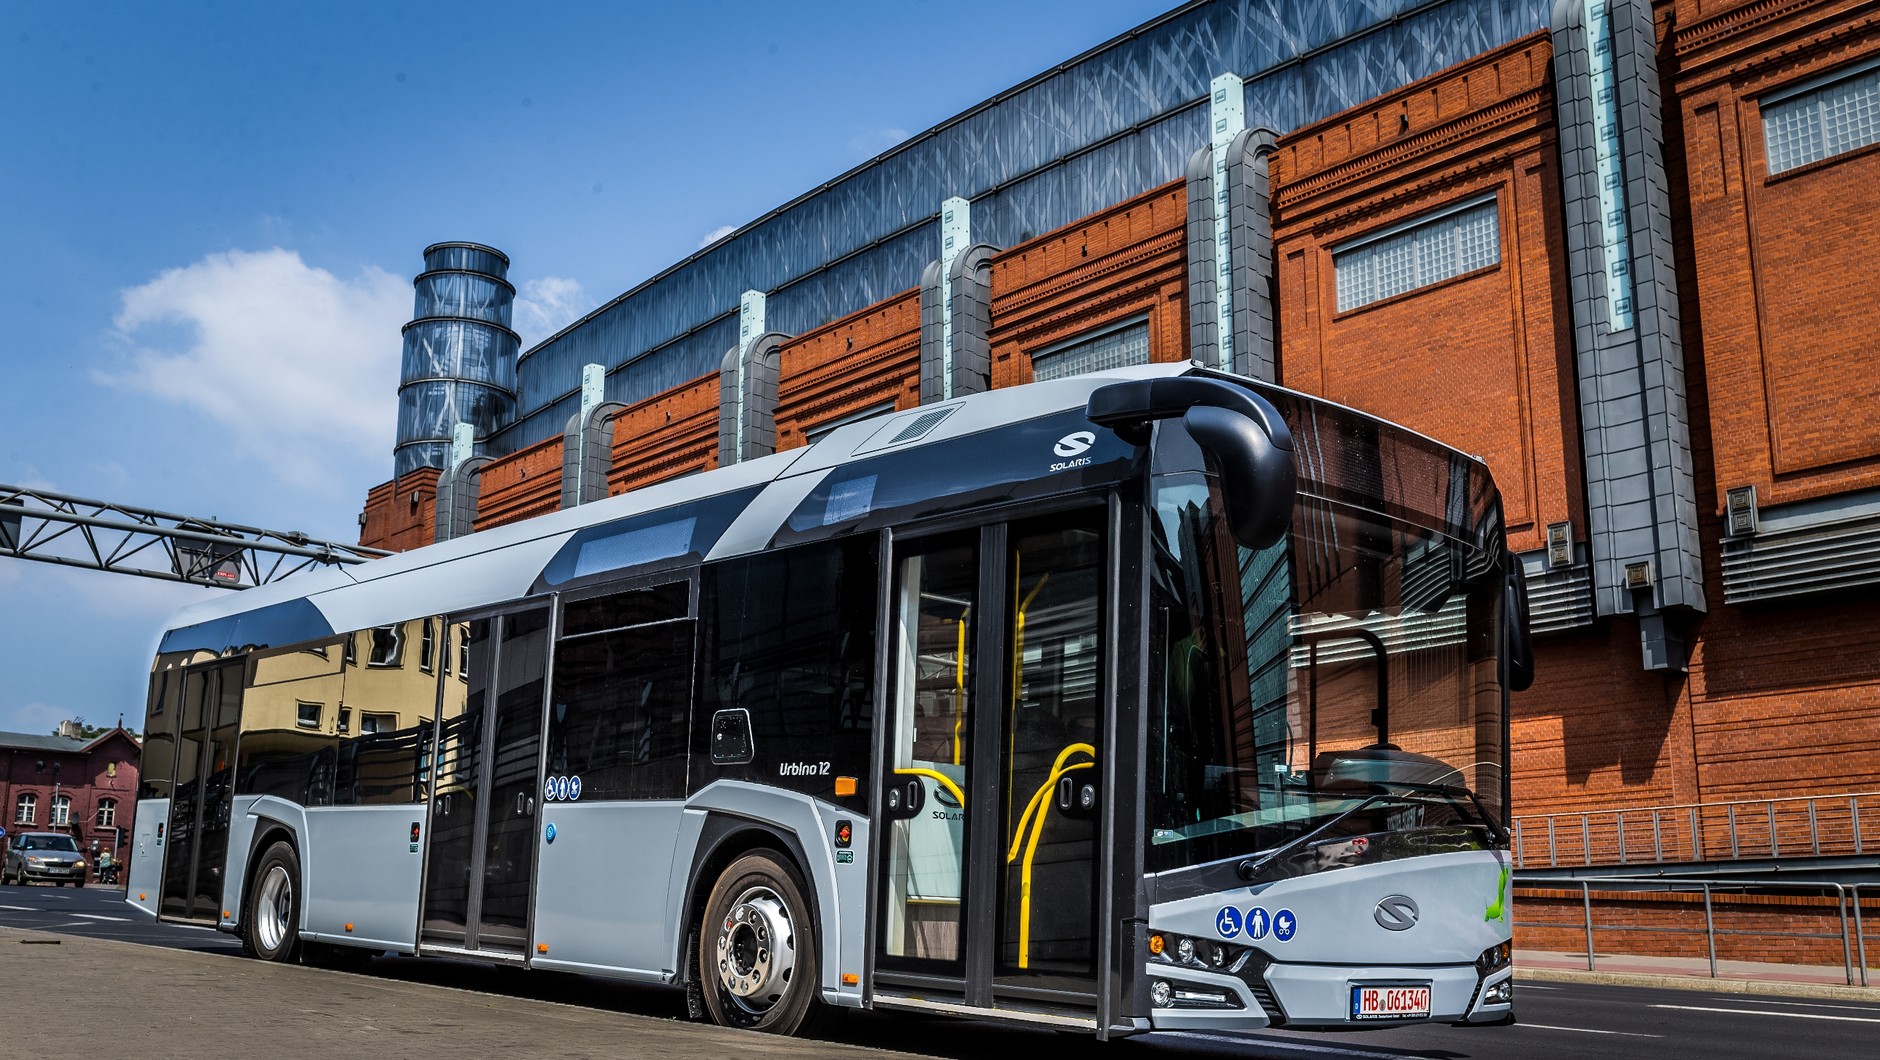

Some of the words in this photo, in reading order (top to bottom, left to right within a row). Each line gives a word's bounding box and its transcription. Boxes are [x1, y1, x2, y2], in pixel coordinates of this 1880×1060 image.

[1049, 456, 1092, 472] SOLARIS
[780, 761, 817, 776] Urbino
[819, 761, 831, 776] 12
[1363, 989, 1379, 1011] HB
[1387, 989, 1427, 1011] 061340
